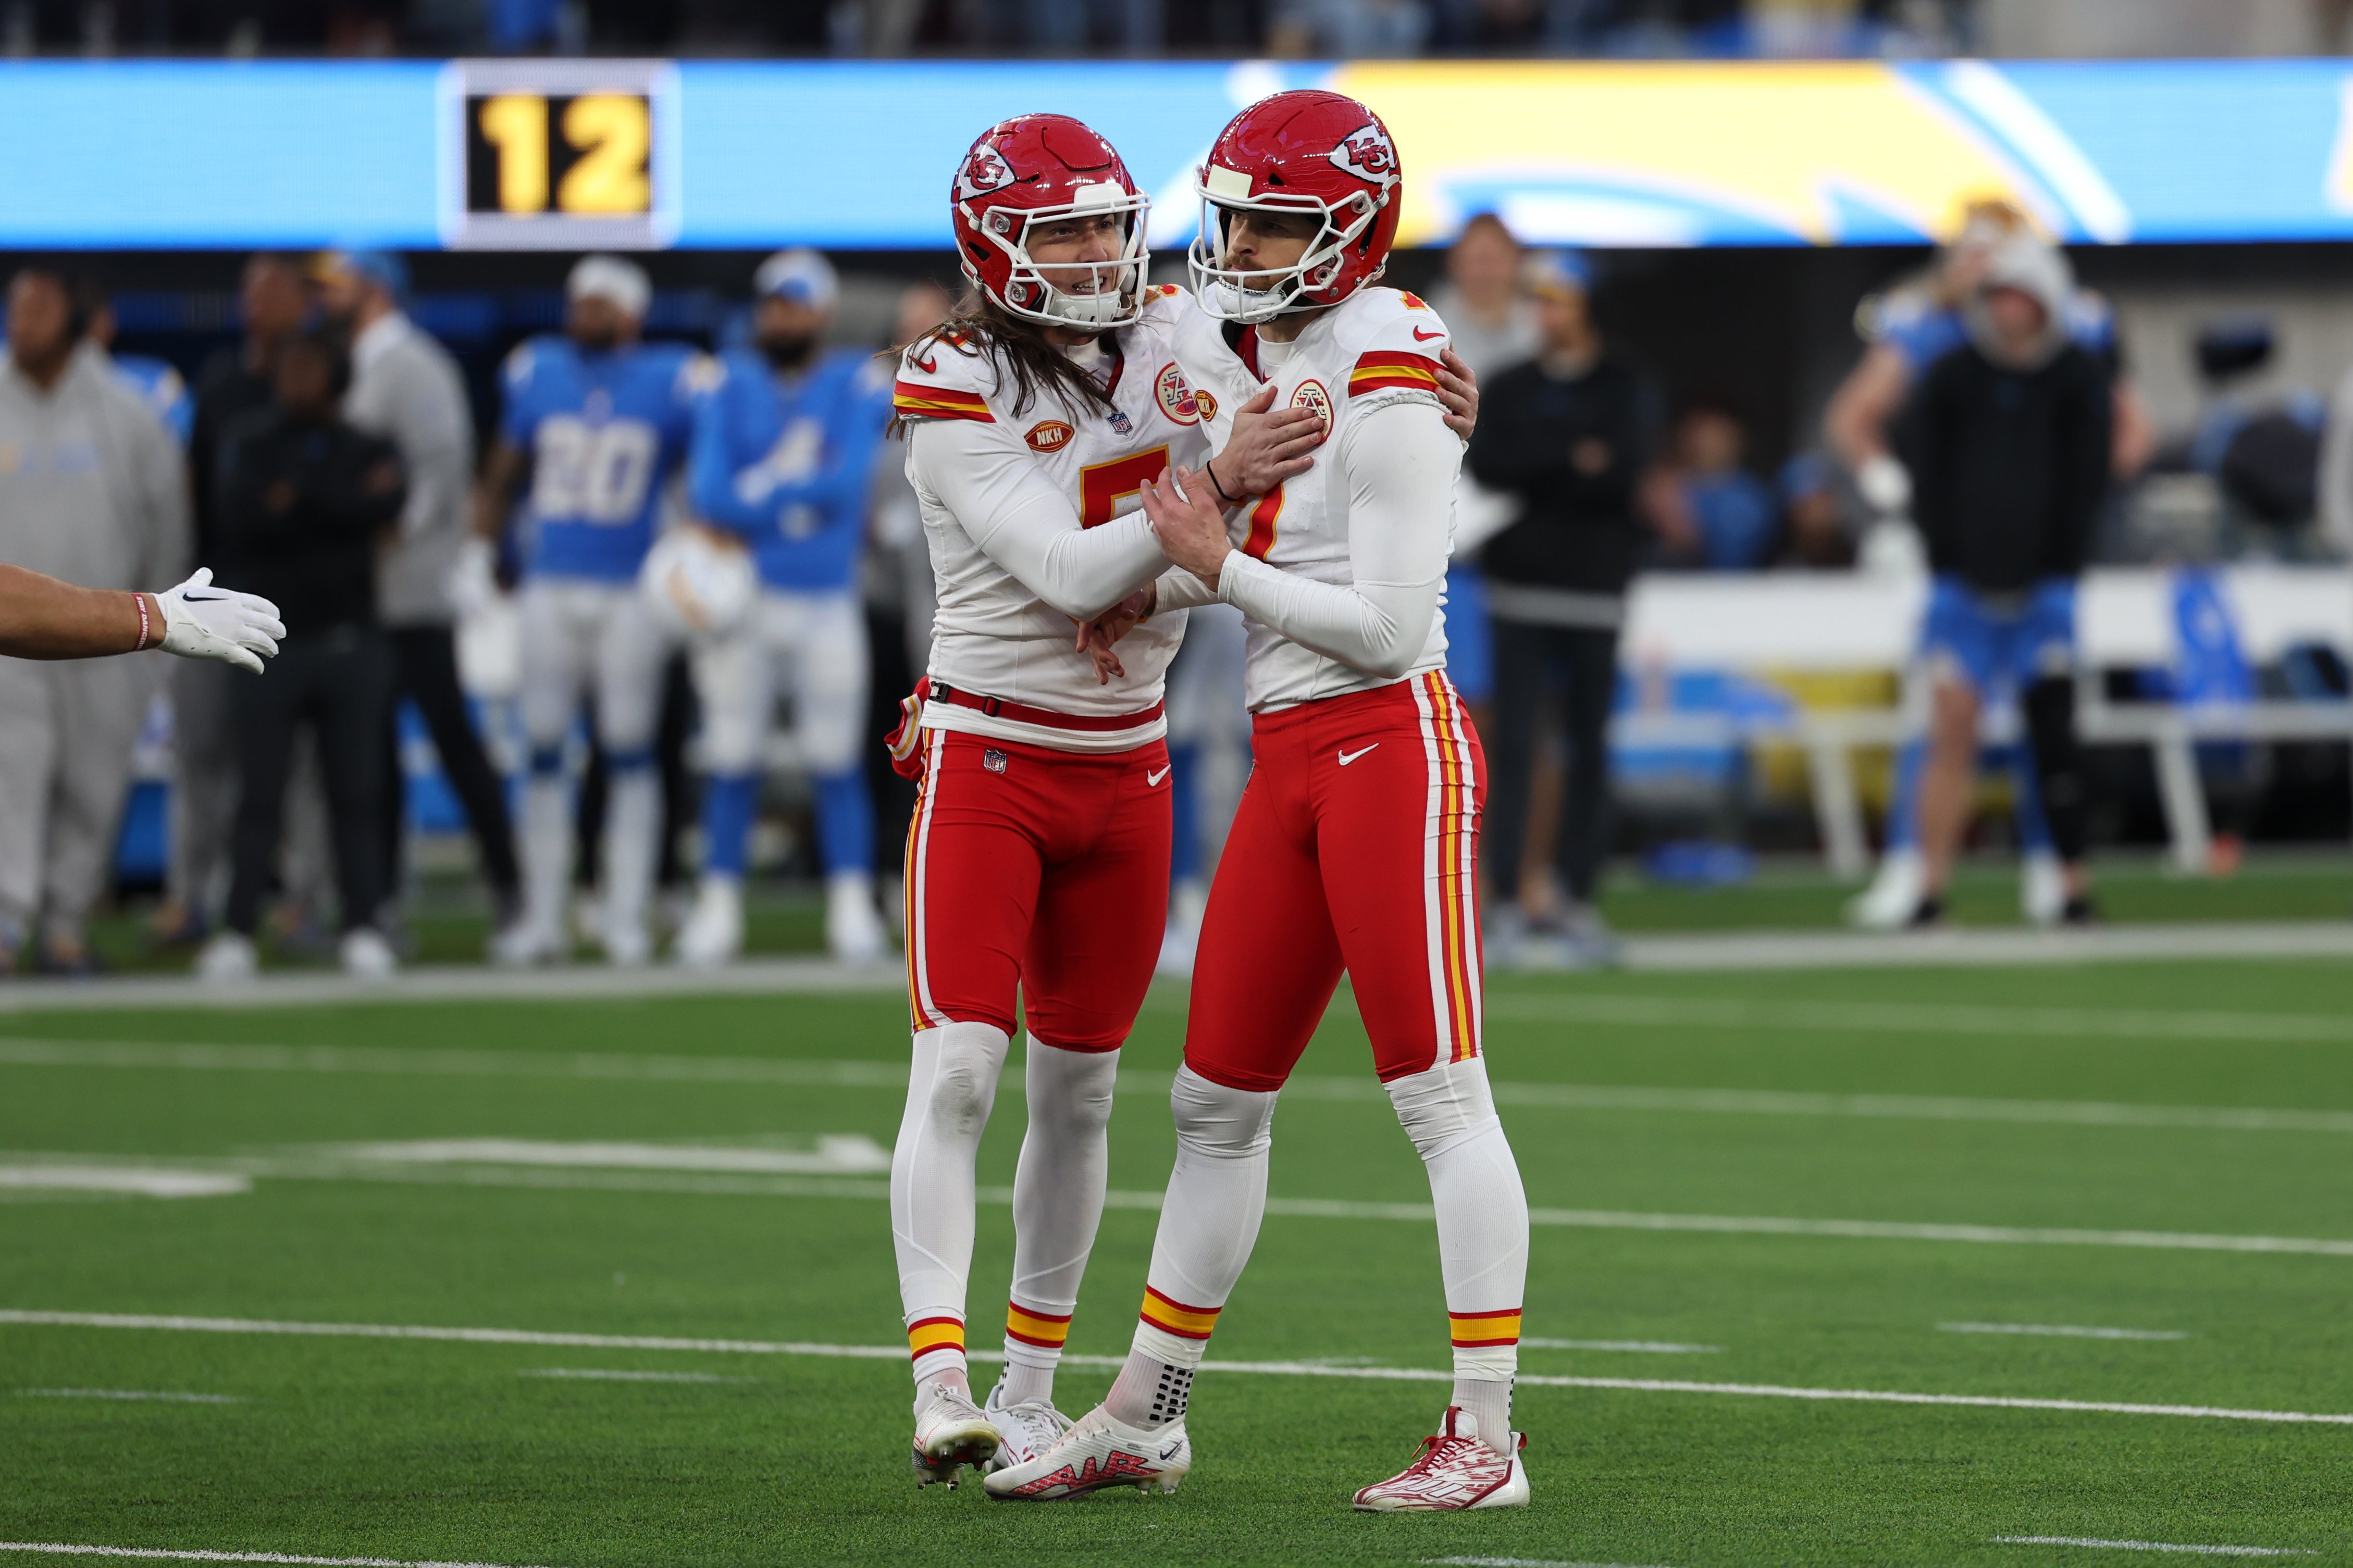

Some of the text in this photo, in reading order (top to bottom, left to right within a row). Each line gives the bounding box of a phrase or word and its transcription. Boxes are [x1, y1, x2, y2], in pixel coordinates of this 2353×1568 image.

[482, 92, 650, 215] 12
[964, 153, 1005, 190] KC
[1344, 138, 1390, 174] KC
[1036, 427, 1063, 446] NKH
[1113, 419, 1130, 431] NFL
[136, 596, 148, 651] STAY DANGERO
[988, 758, 1002, 770] NFL
